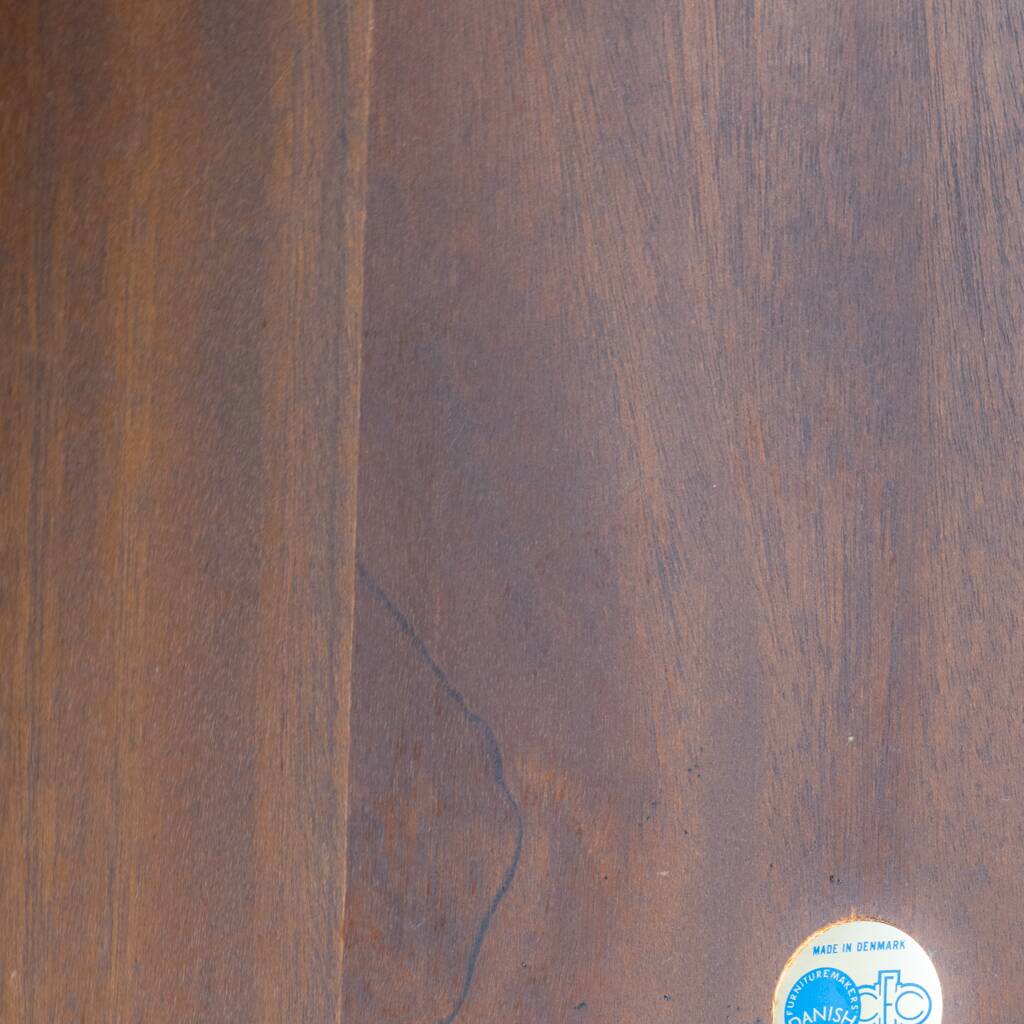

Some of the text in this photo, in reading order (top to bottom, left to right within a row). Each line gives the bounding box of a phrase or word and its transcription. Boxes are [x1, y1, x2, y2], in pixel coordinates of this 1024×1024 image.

[813, 940, 906, 956] MADE IN DENMARK
